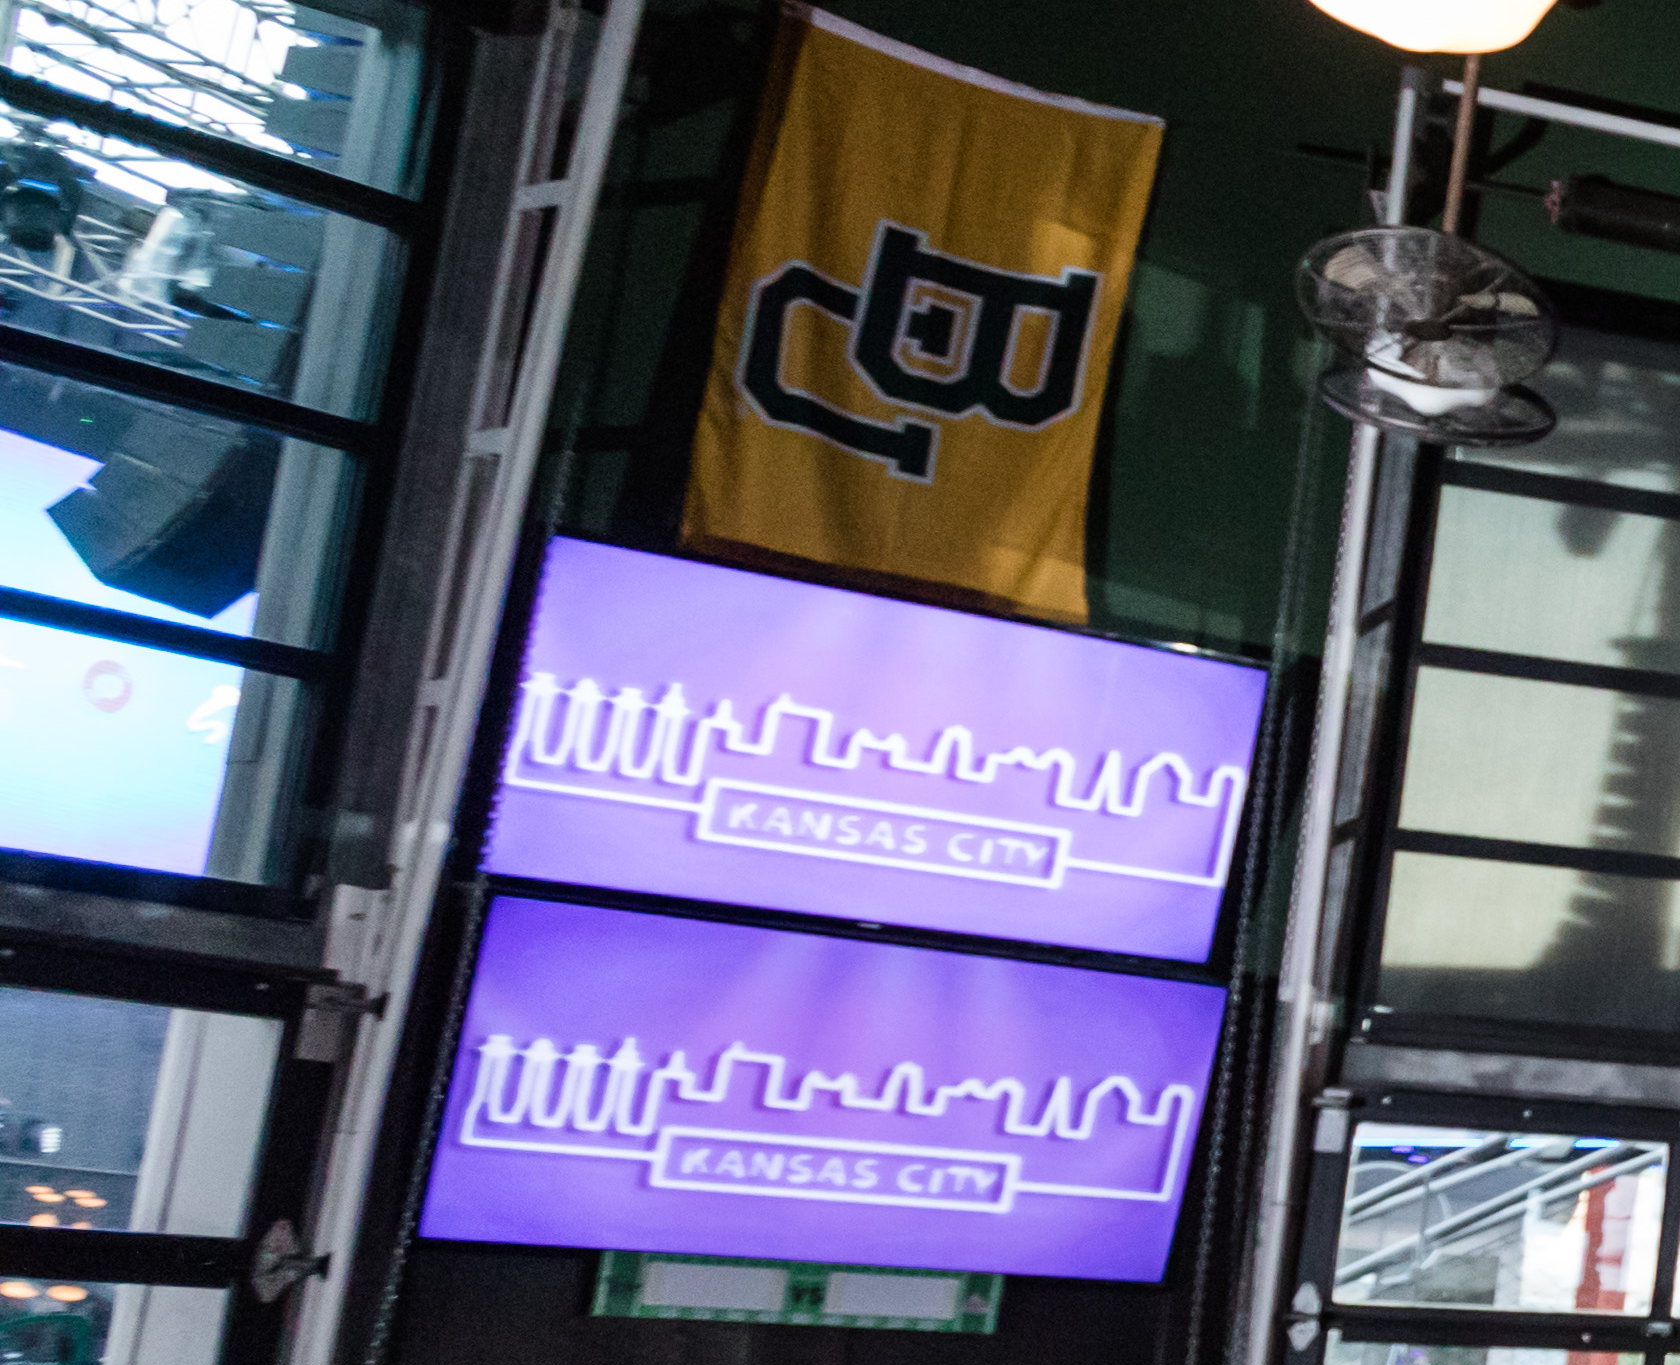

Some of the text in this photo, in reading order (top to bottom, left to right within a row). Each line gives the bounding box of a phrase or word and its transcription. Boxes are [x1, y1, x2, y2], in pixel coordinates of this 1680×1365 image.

[726, 798, 1055, 878] KANSAS CITY
[679, 1144, 1001, 1206] KANSAS CITY
